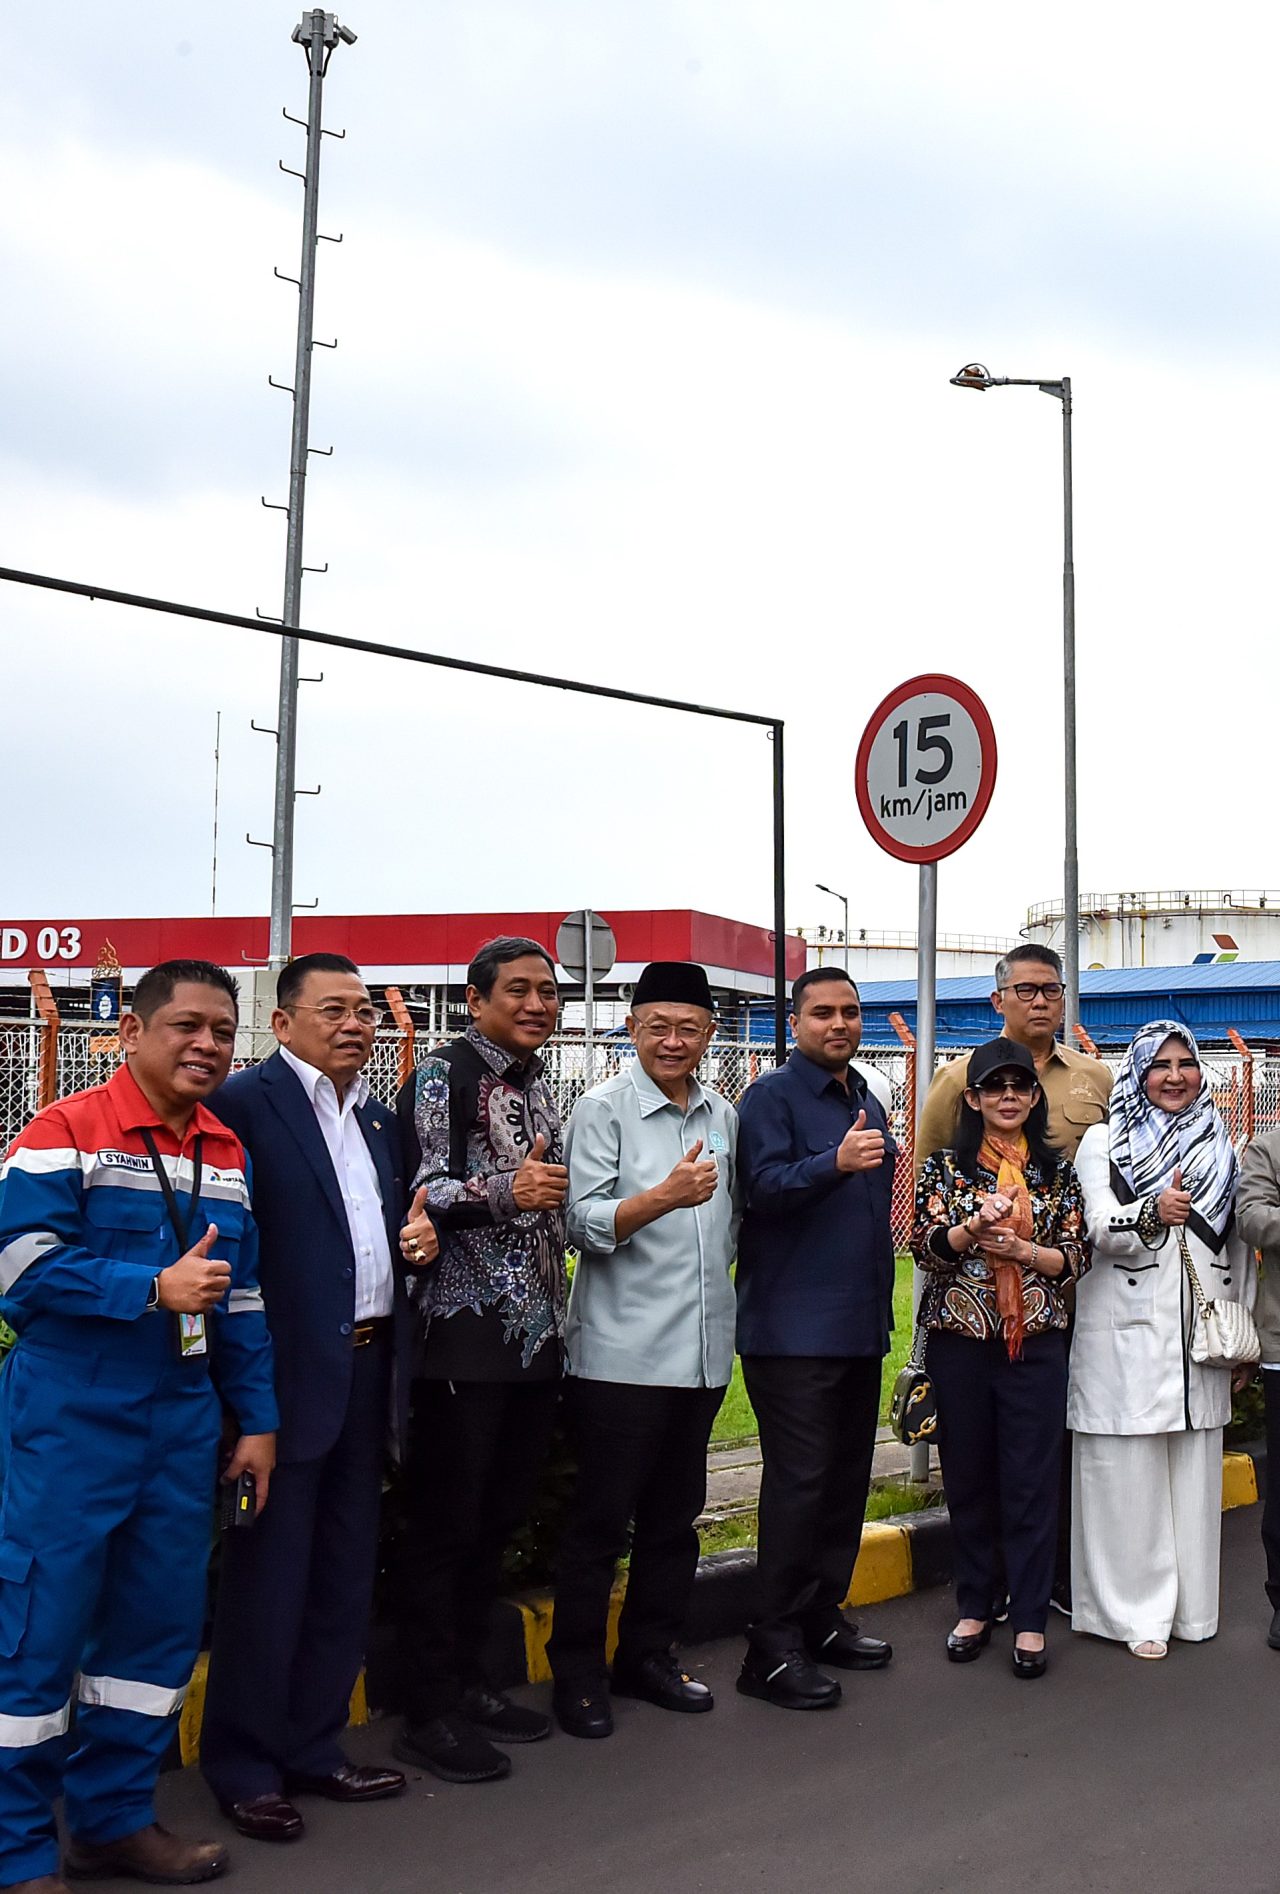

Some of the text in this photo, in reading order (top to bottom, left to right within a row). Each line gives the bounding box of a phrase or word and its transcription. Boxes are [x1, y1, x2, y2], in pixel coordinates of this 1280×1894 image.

[893, 713, 953, 788] 15
[880, 788, 966, 820] km/jam
[0, 926, 81, 960] D 03
[105, 1153, 149, 1169] SYAHWIN
